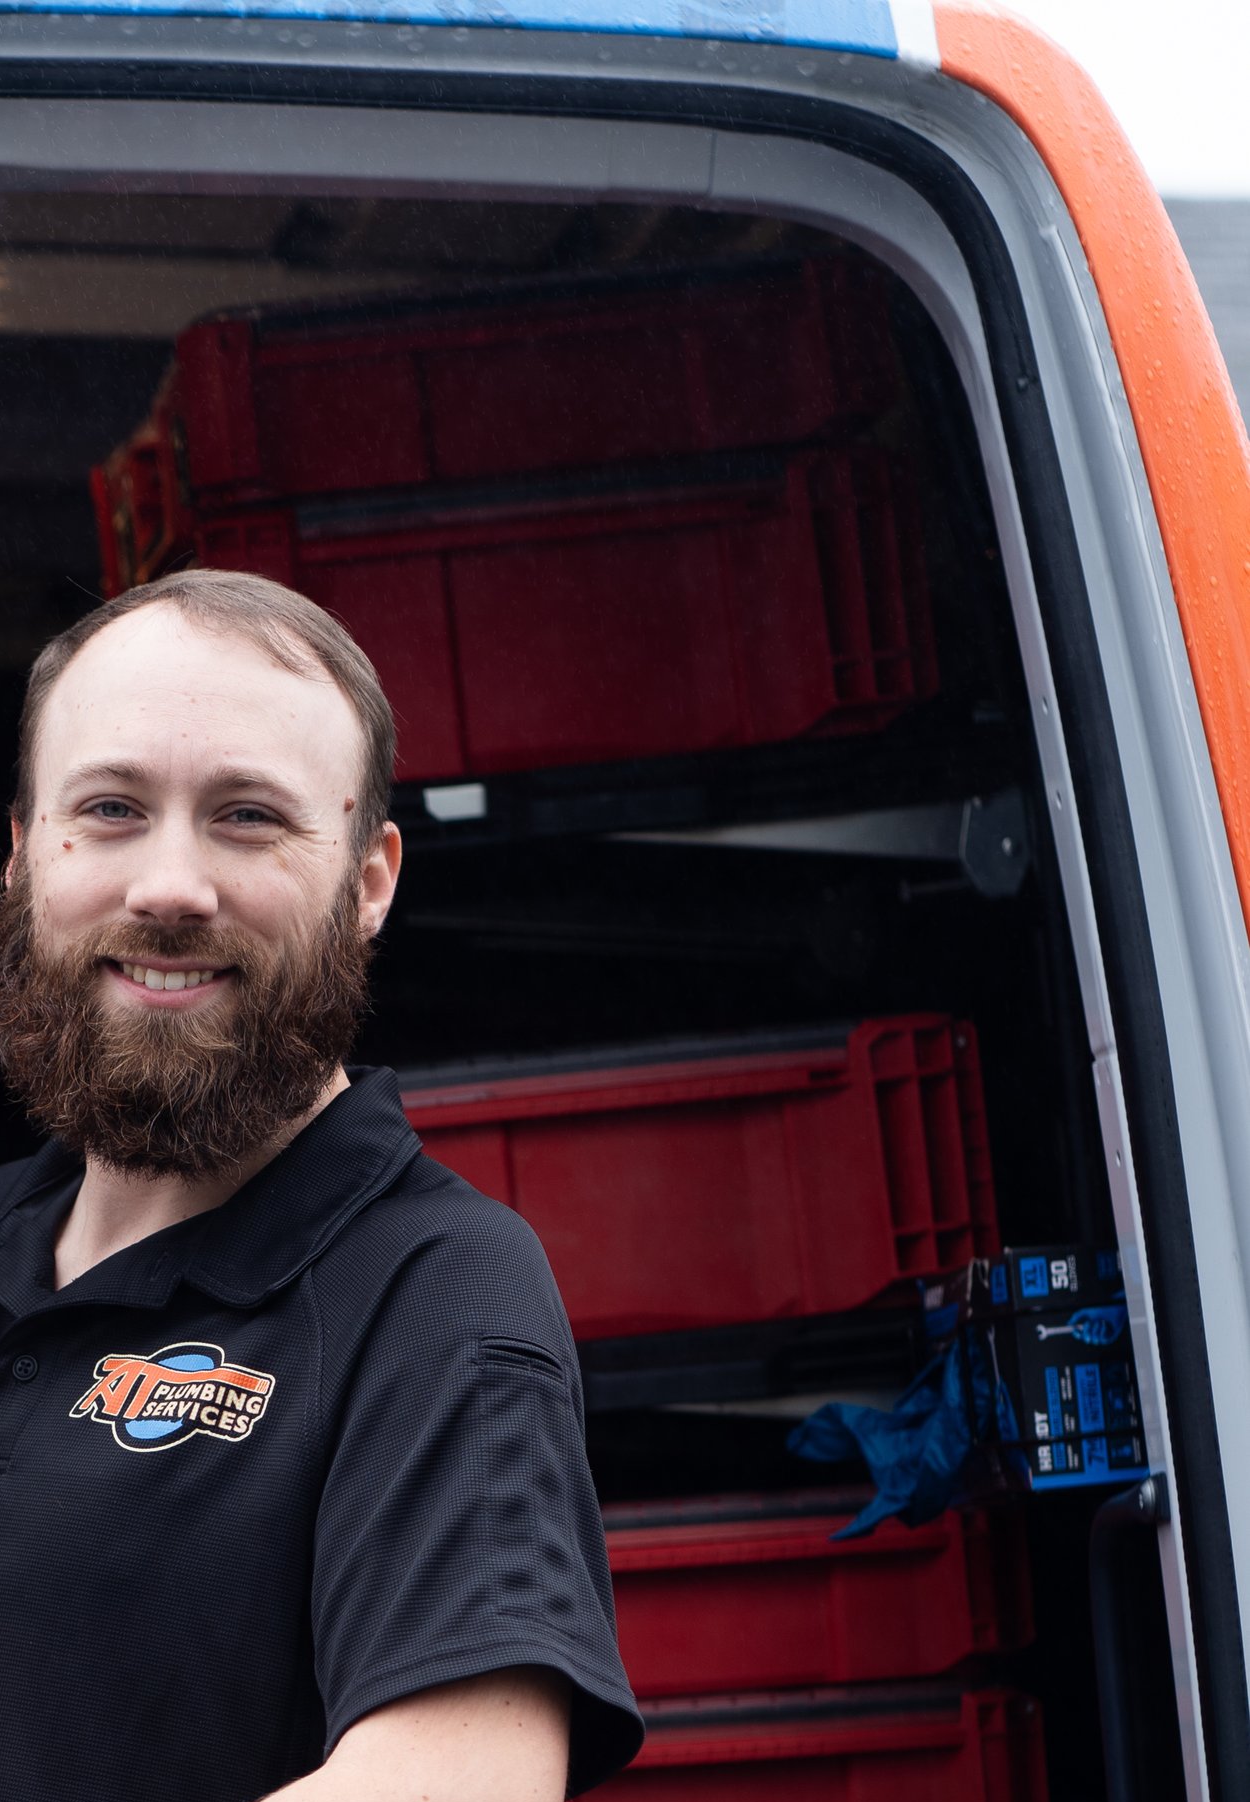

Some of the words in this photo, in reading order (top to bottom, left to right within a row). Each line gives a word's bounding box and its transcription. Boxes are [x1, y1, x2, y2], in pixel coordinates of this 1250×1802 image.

[1050, 1259, 1069, 1290] 50
[154, 1383, 264, 1415] PLUMBING
[141, 1401, 250, 1434] SERVICES
